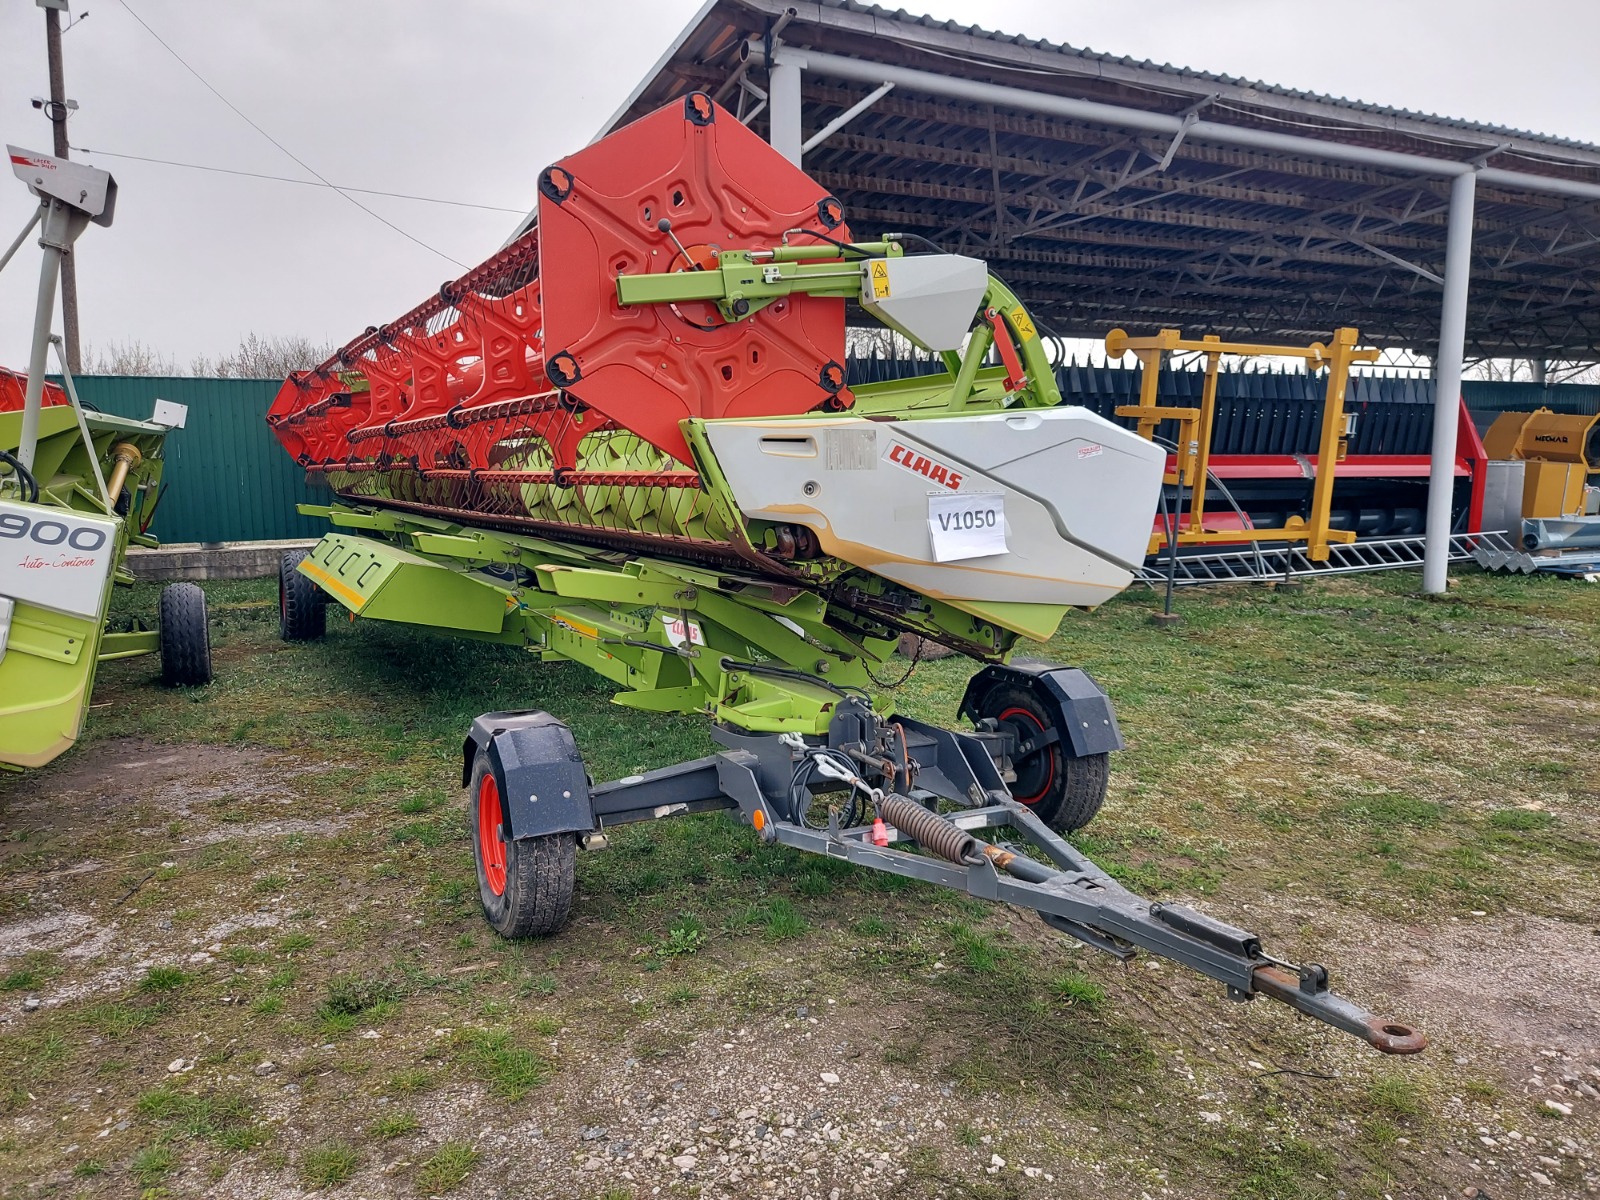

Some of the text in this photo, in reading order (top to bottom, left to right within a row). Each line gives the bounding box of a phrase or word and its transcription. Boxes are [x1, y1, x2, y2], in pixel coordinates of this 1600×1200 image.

[889, 444, 963, 491] CLAAS
[0, 513, 107, 552] 900
[937, 509, 997, 532] V1050
[18, 553, 97, 569] Auto-Contour
